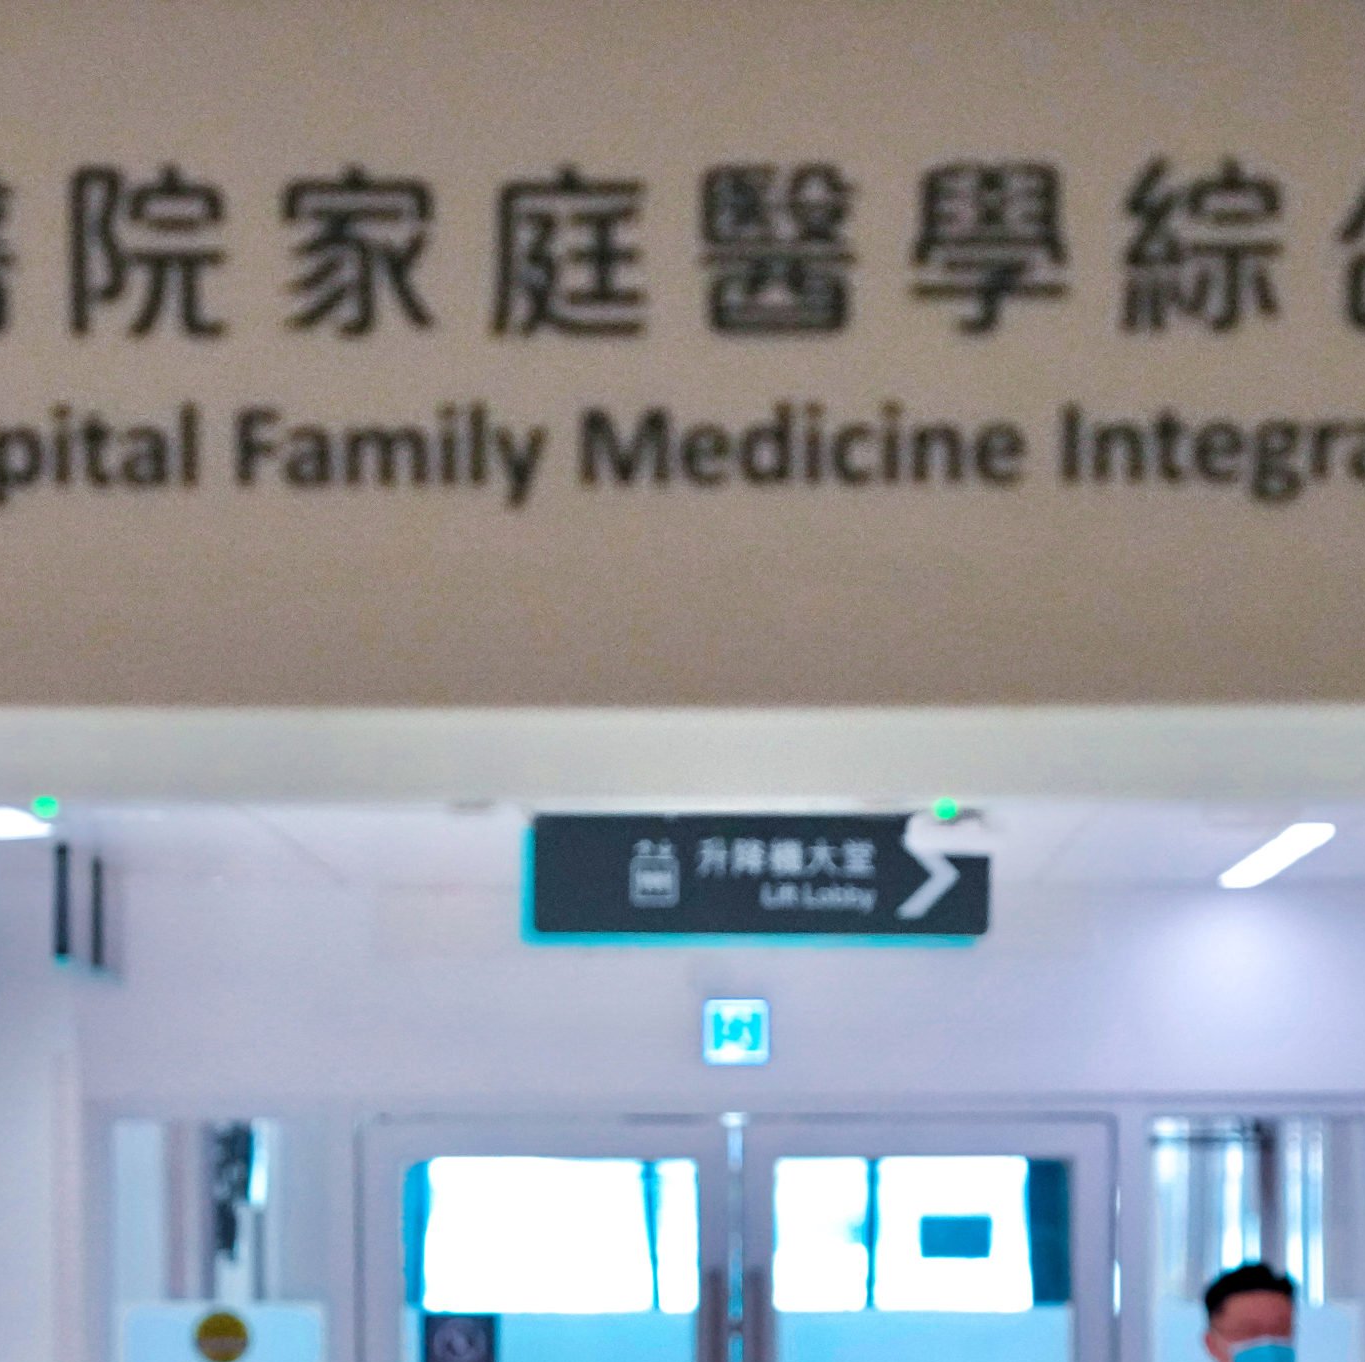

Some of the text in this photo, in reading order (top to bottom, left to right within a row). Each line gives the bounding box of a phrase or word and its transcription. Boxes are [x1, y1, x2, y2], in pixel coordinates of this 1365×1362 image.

[236, 405, 544, 505] Family
[579, 404, 1025, 486] Medicine
[801, 882, 877, 915] Lobby
